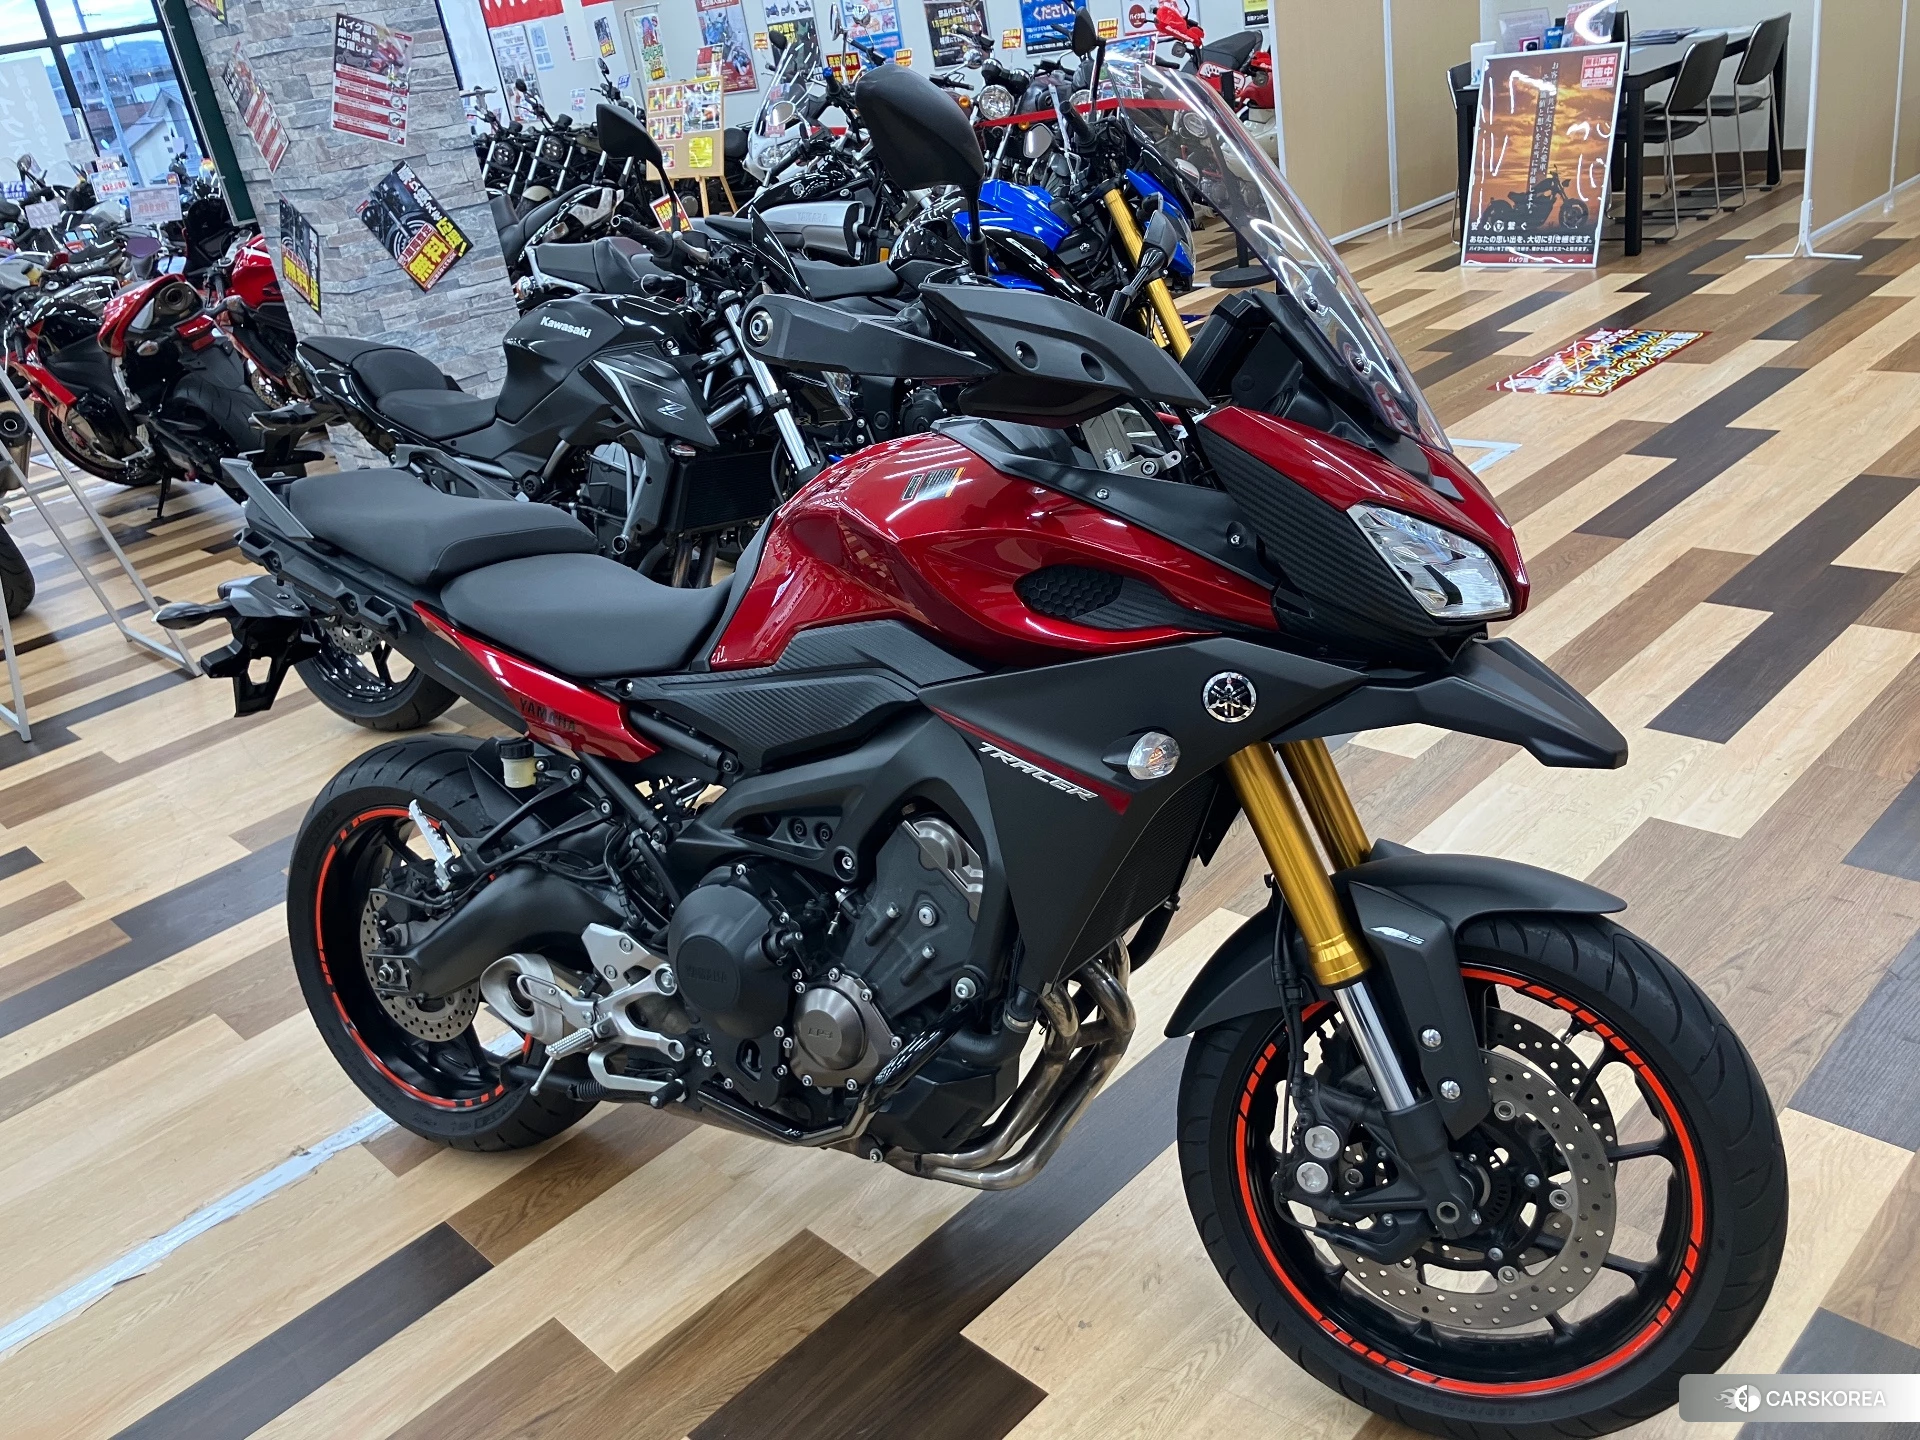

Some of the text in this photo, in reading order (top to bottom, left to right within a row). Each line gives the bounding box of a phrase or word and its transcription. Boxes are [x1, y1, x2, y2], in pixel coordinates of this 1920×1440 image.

[409, 236, 449, 282] 無料
[540, 315, 592, 339] Kawasaki
[519, 696, 576, 733] YAMAHA
[979, 741, 1098, 801] TRACER
